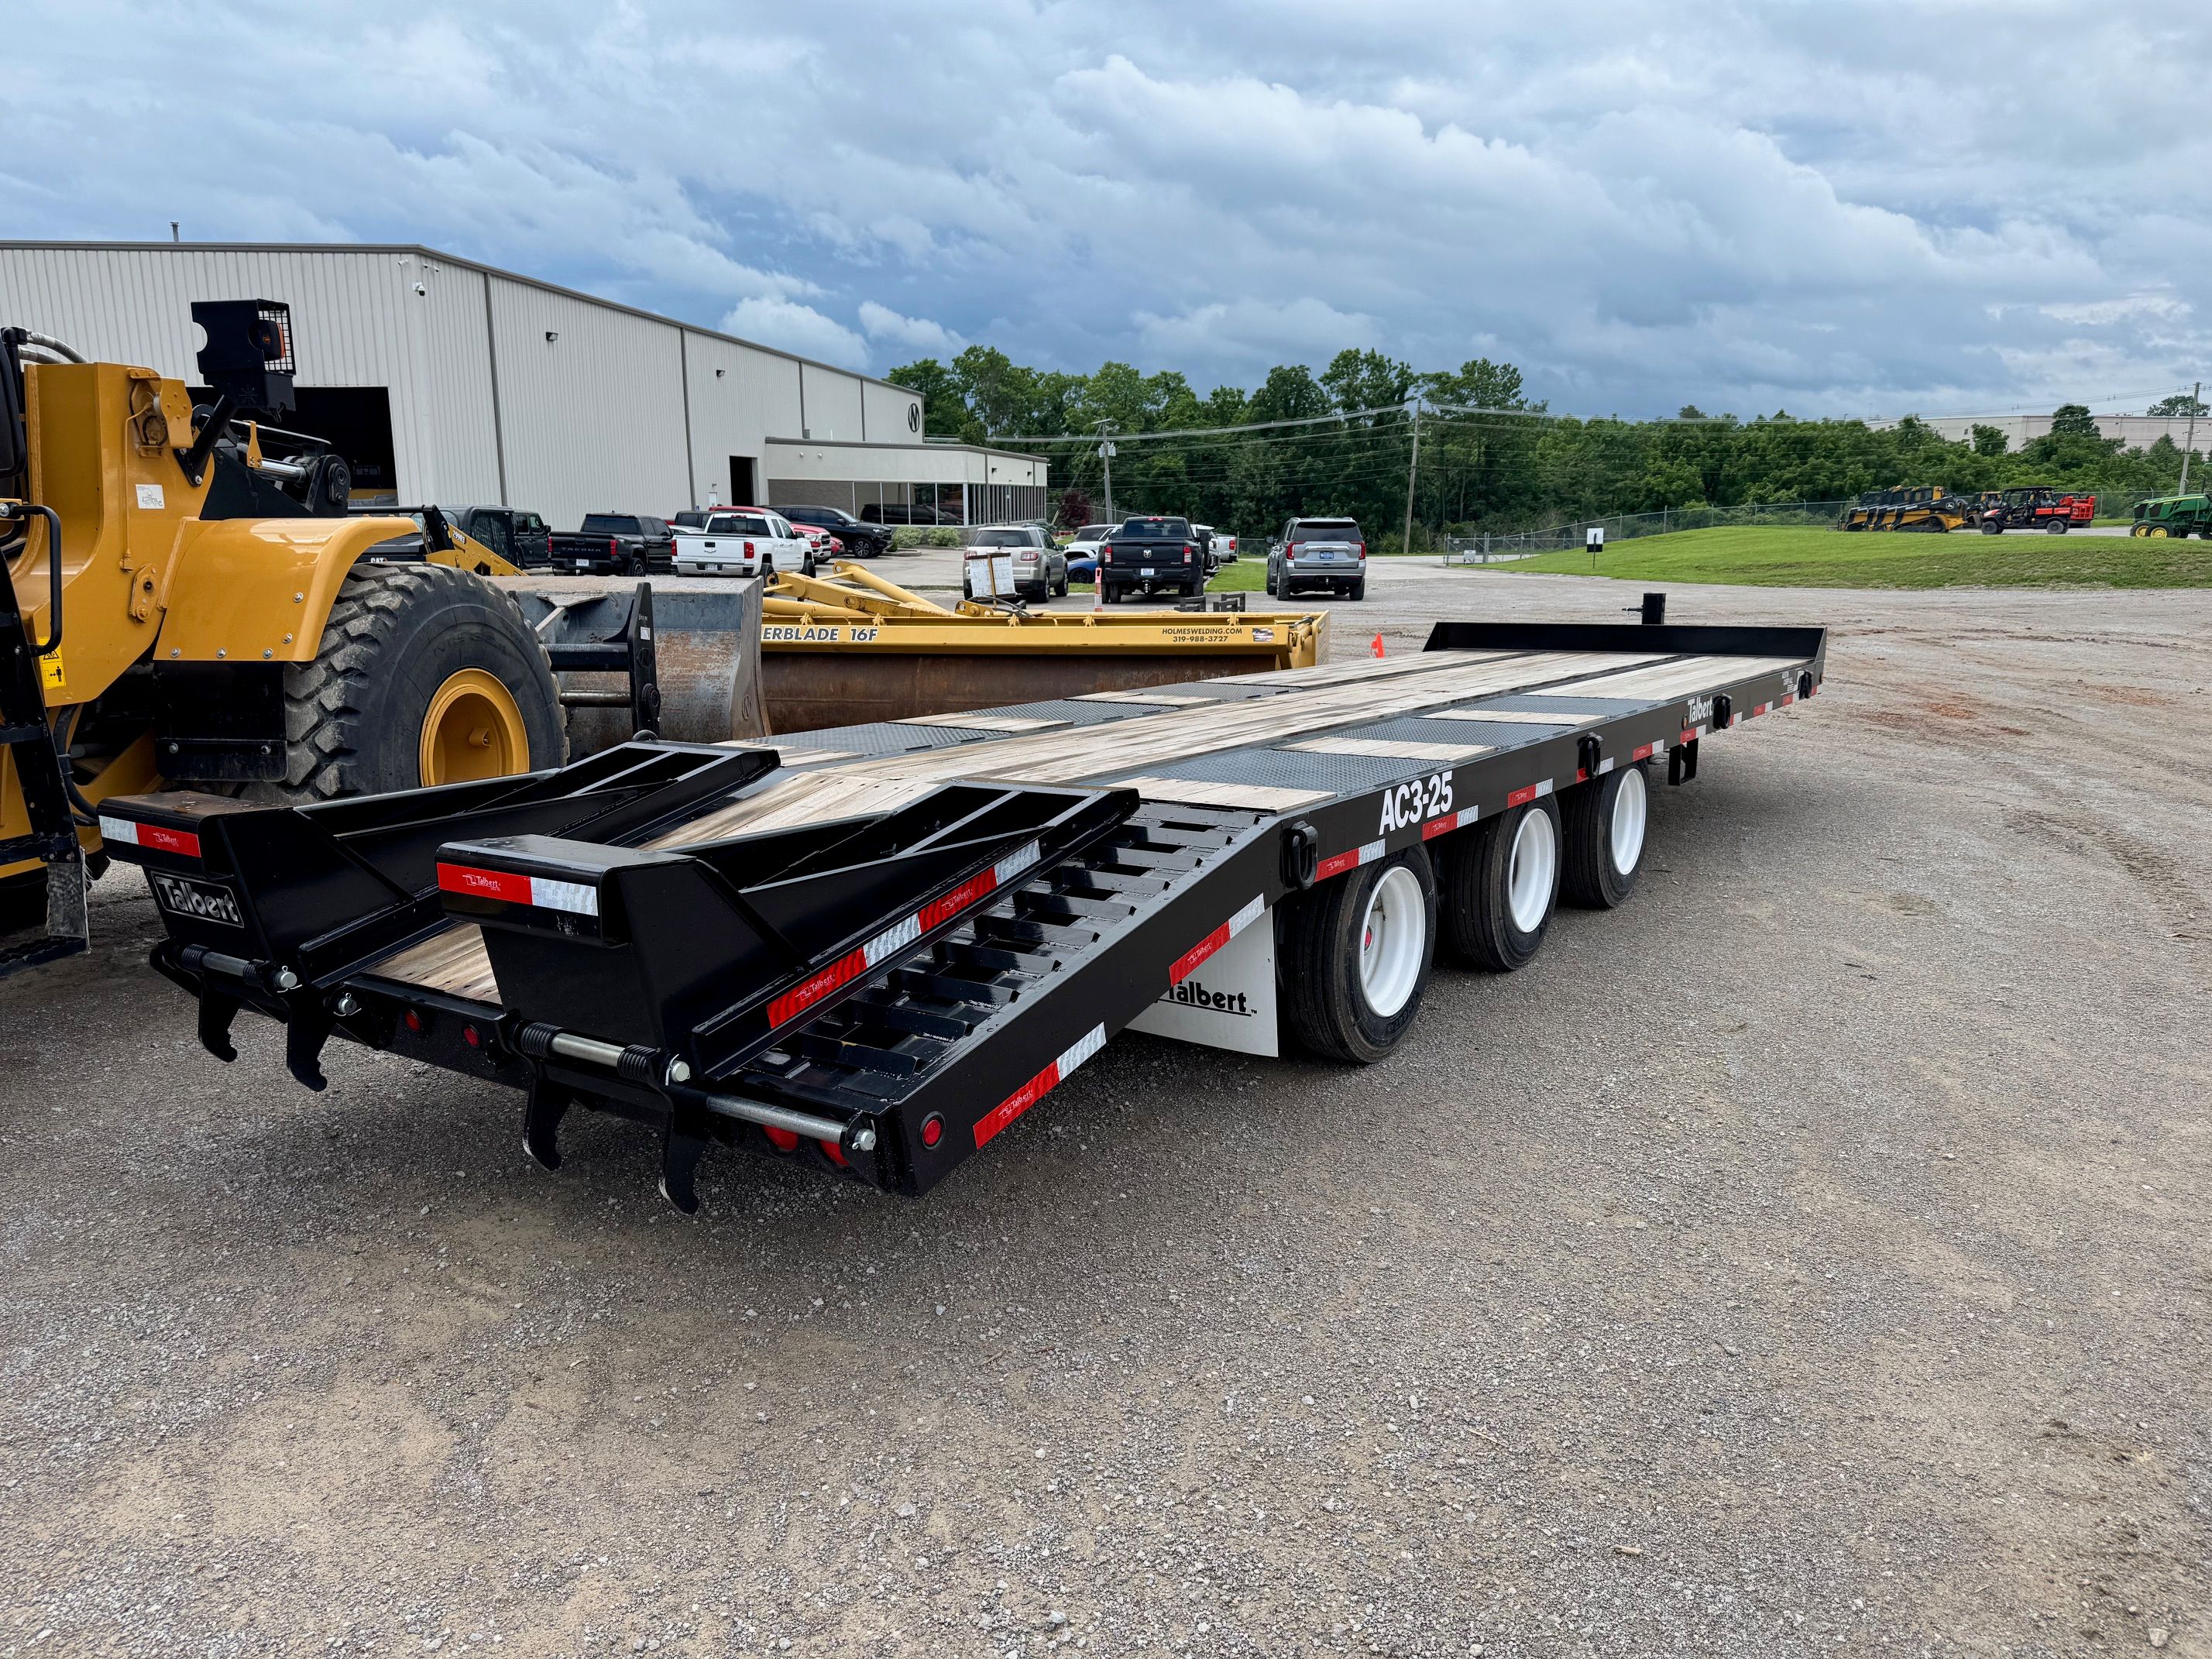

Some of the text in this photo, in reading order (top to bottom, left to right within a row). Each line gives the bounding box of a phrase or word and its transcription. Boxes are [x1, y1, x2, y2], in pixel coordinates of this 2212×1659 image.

[850, 628, 878, 641] 16F
[1687, 695, 1713, 724] Talbert
[1378, 770, 1453, 836] AC3-25
[476, 875, 498, 888] Talbert
[155, 876, 239, 922] Talbert
[953, 888, 971, 904] Talbert
[810, 974, 833, 991] Talbert
[1011, 1091, 1032, 1108] Talbert
